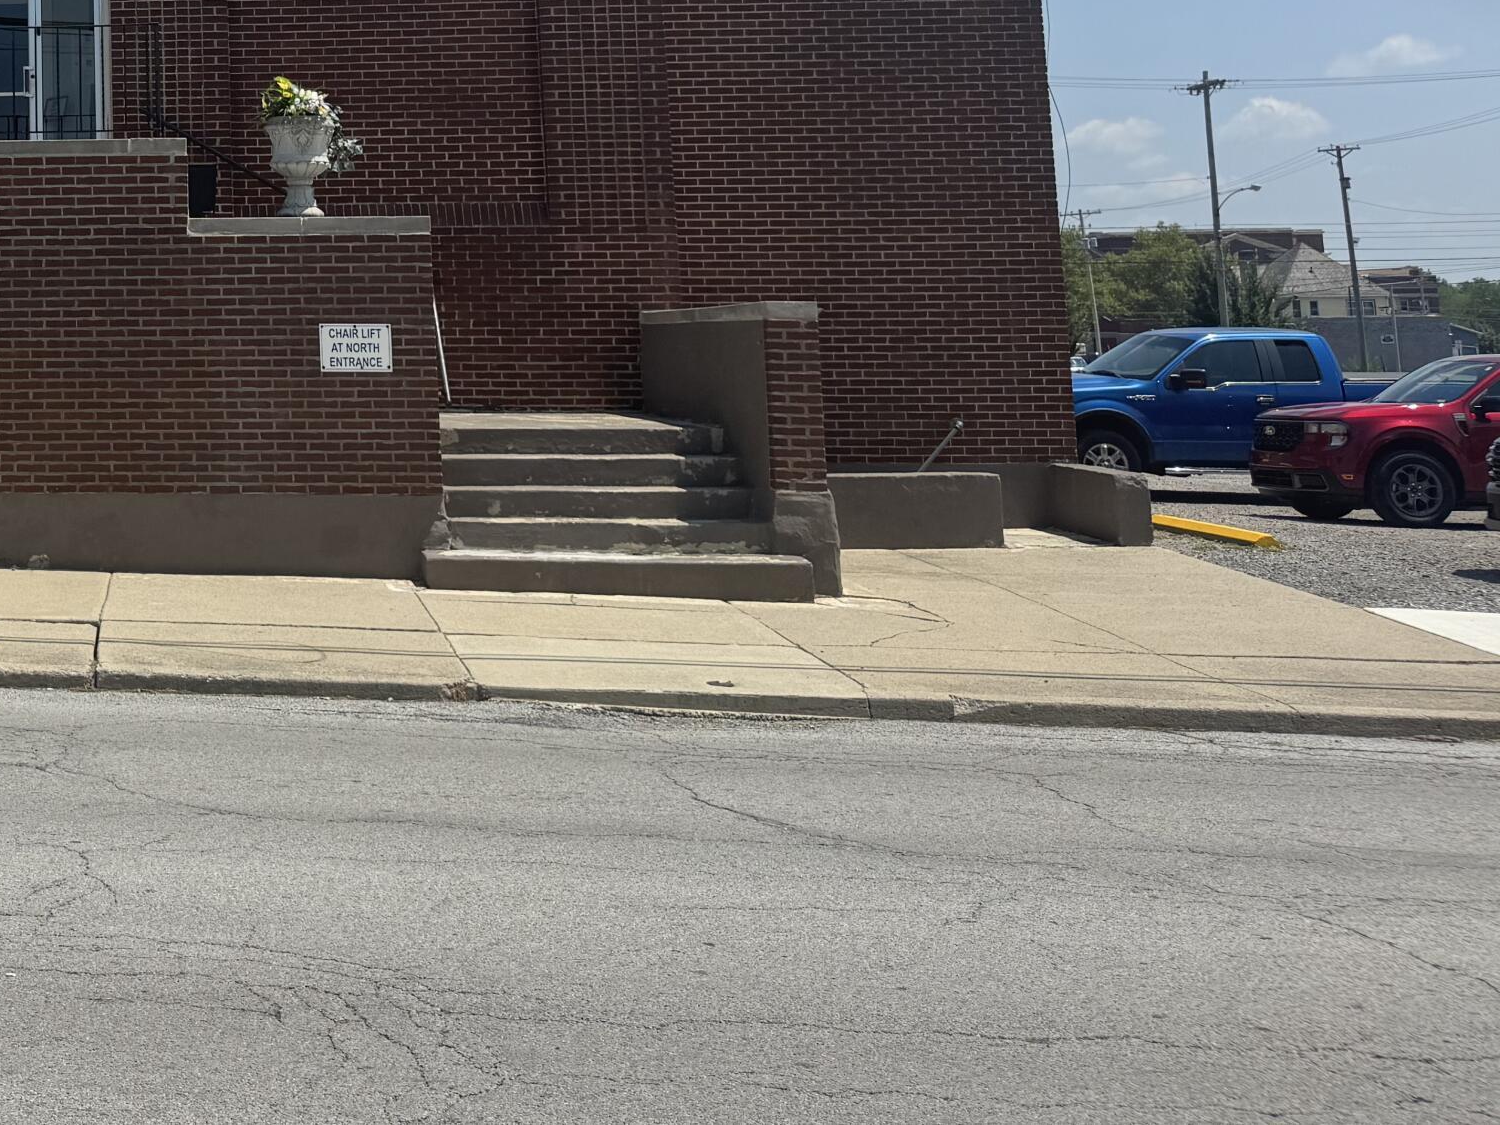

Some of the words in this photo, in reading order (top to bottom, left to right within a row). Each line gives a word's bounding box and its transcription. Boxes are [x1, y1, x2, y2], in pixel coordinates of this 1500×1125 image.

[328, 328, 360, 339] CHAIR
[361, 328, 382, 339] LIFT
[331, 342, 343, 353] AT
[346, 342, 380, 353] NORTH
[329, 356, 383, 368] ENTRANCE
